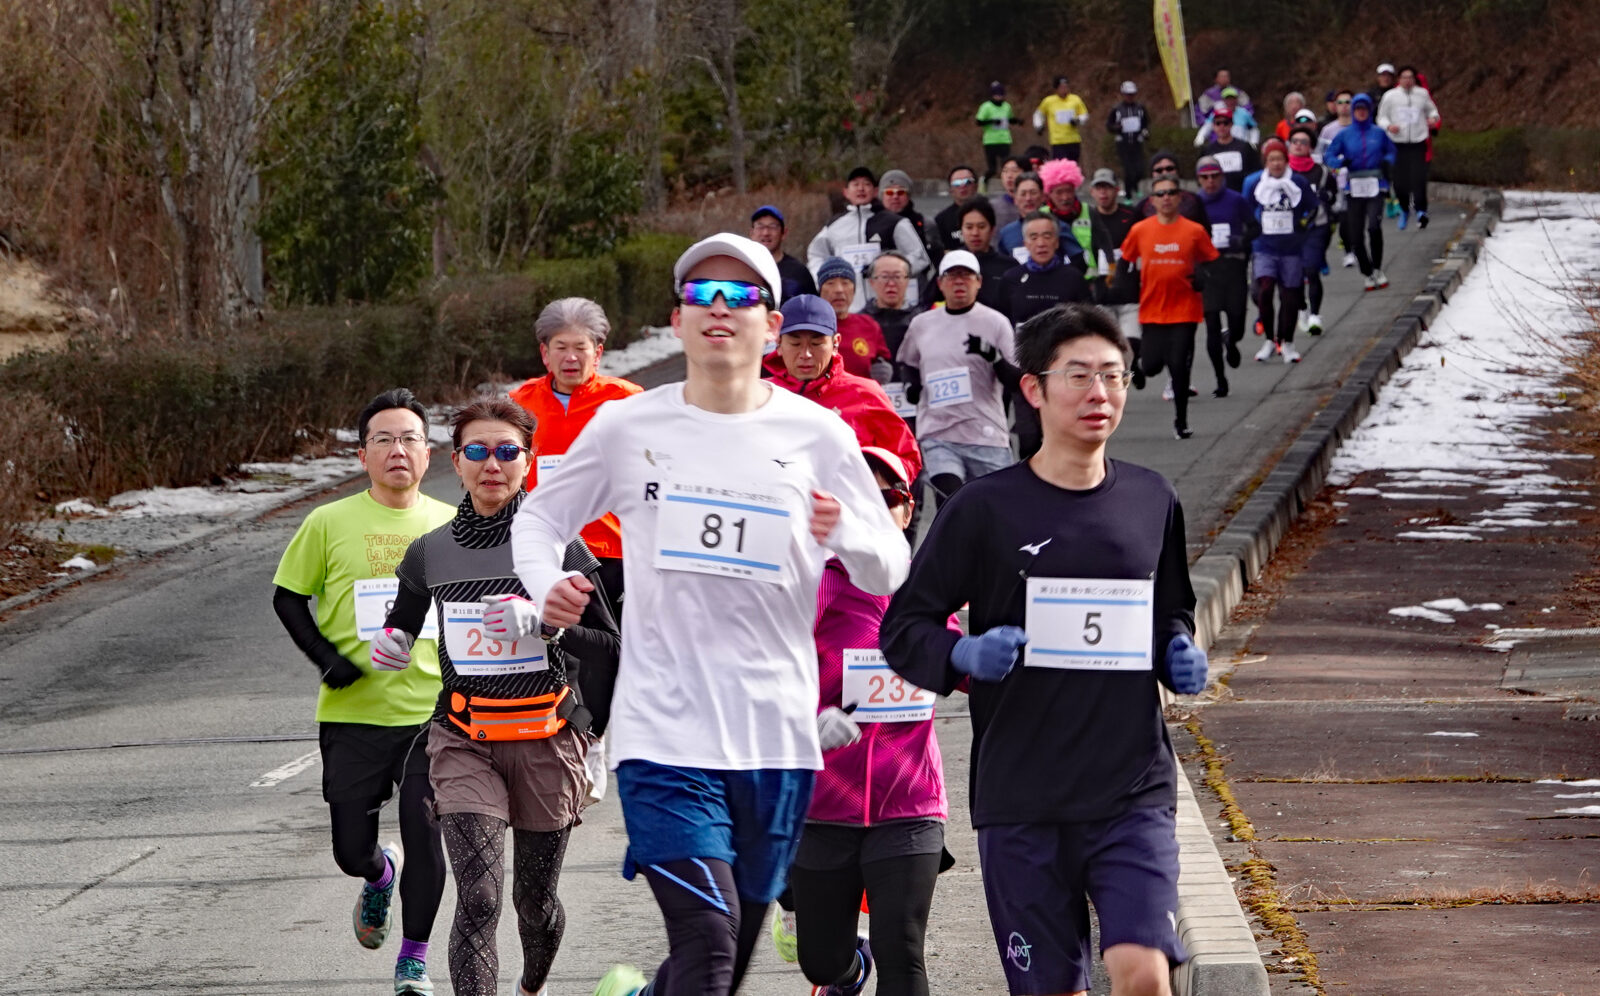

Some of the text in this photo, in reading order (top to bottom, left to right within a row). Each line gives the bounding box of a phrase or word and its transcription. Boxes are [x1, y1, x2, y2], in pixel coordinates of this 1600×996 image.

[933, 380, 960, 398] 229
[364, 534, 419, 548] TENDO
[701, 513, 746, 553] 81
[384, 548, 407, 561] Fra
[371, 562, 398, 577] Mar
[1083, 612, 1102, 645] 5
